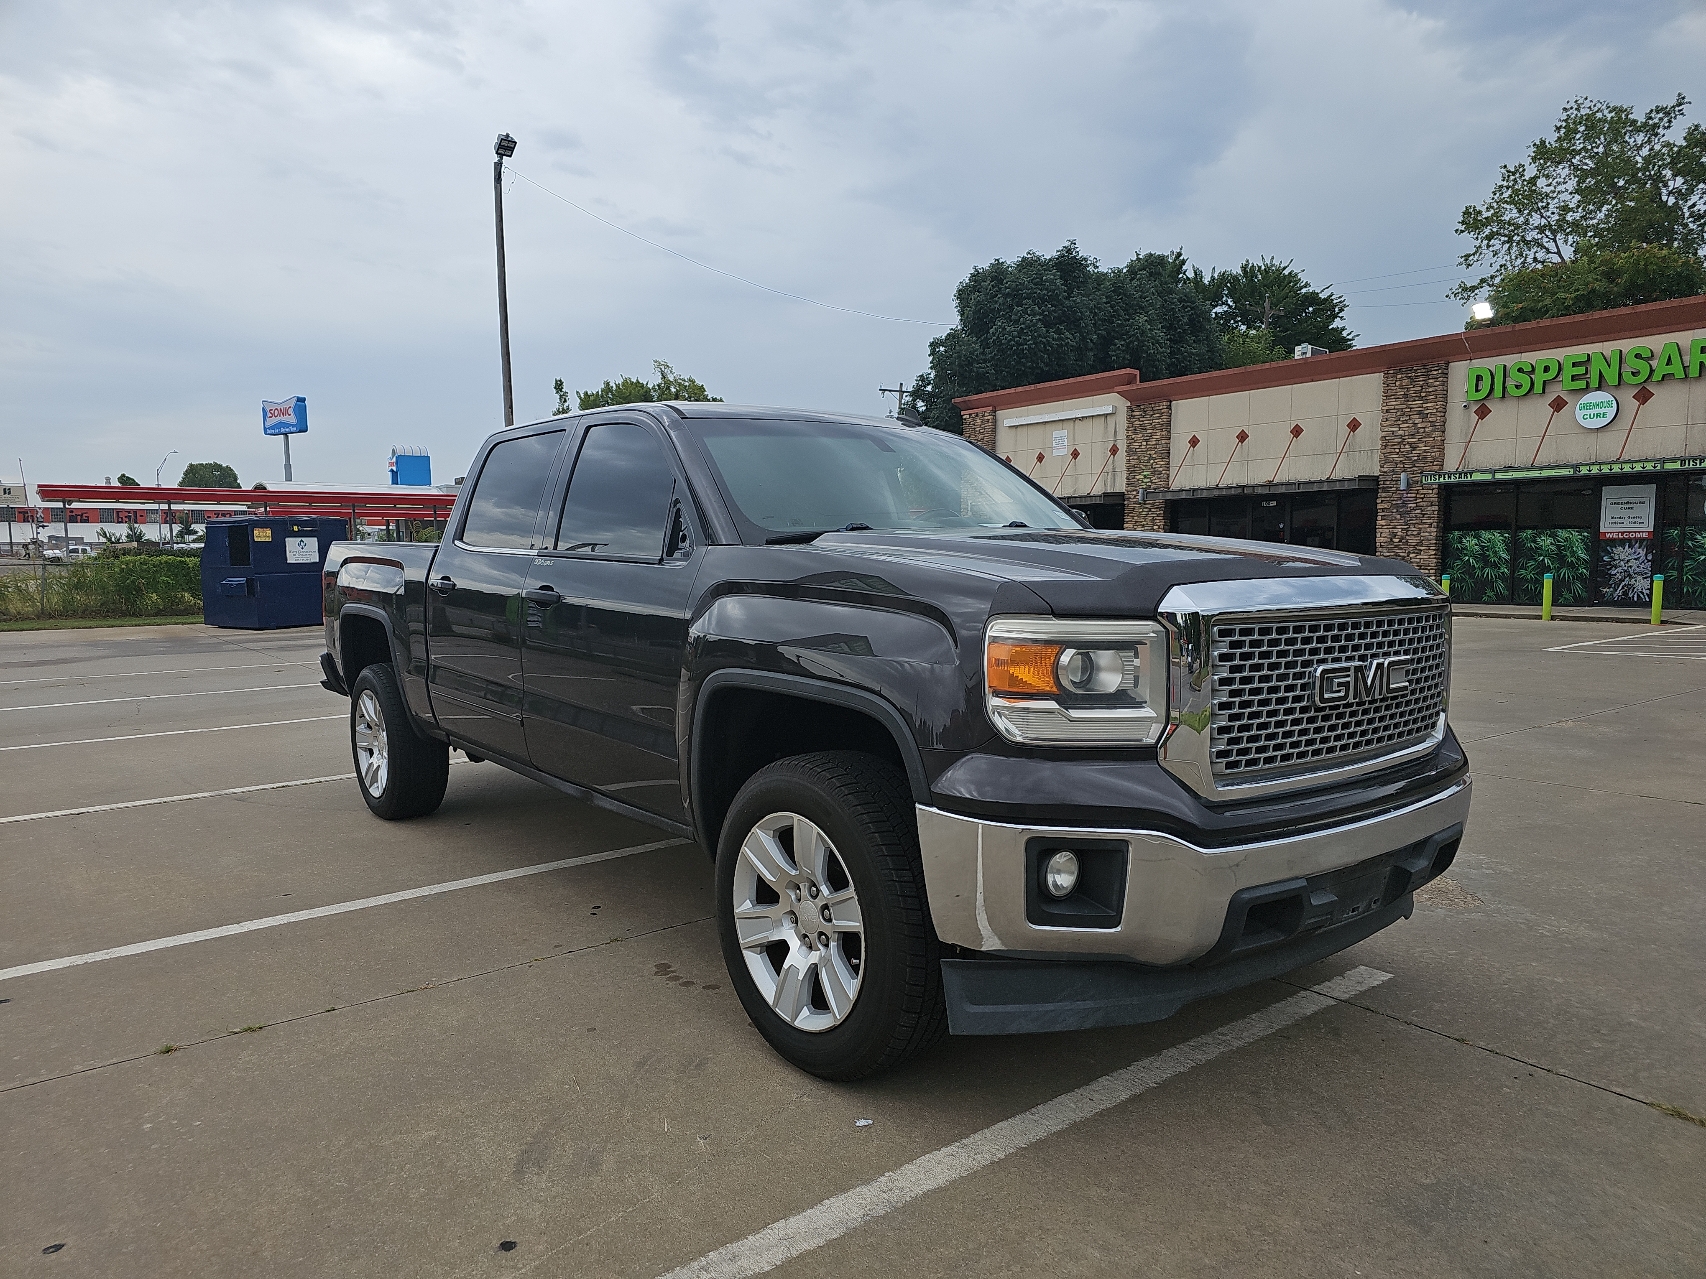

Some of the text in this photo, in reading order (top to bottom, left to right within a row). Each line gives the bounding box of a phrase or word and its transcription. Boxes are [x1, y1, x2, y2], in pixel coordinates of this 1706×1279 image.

[1578, 399, 1614, 411] GREENHOUSE
[268, 406, 292, 418] SONIC
[1582, 411, 1608, 420] CURE
[1424, 472, 1473, 482] DISPENSARY
[1312, 655, 1411, 708] GMC
